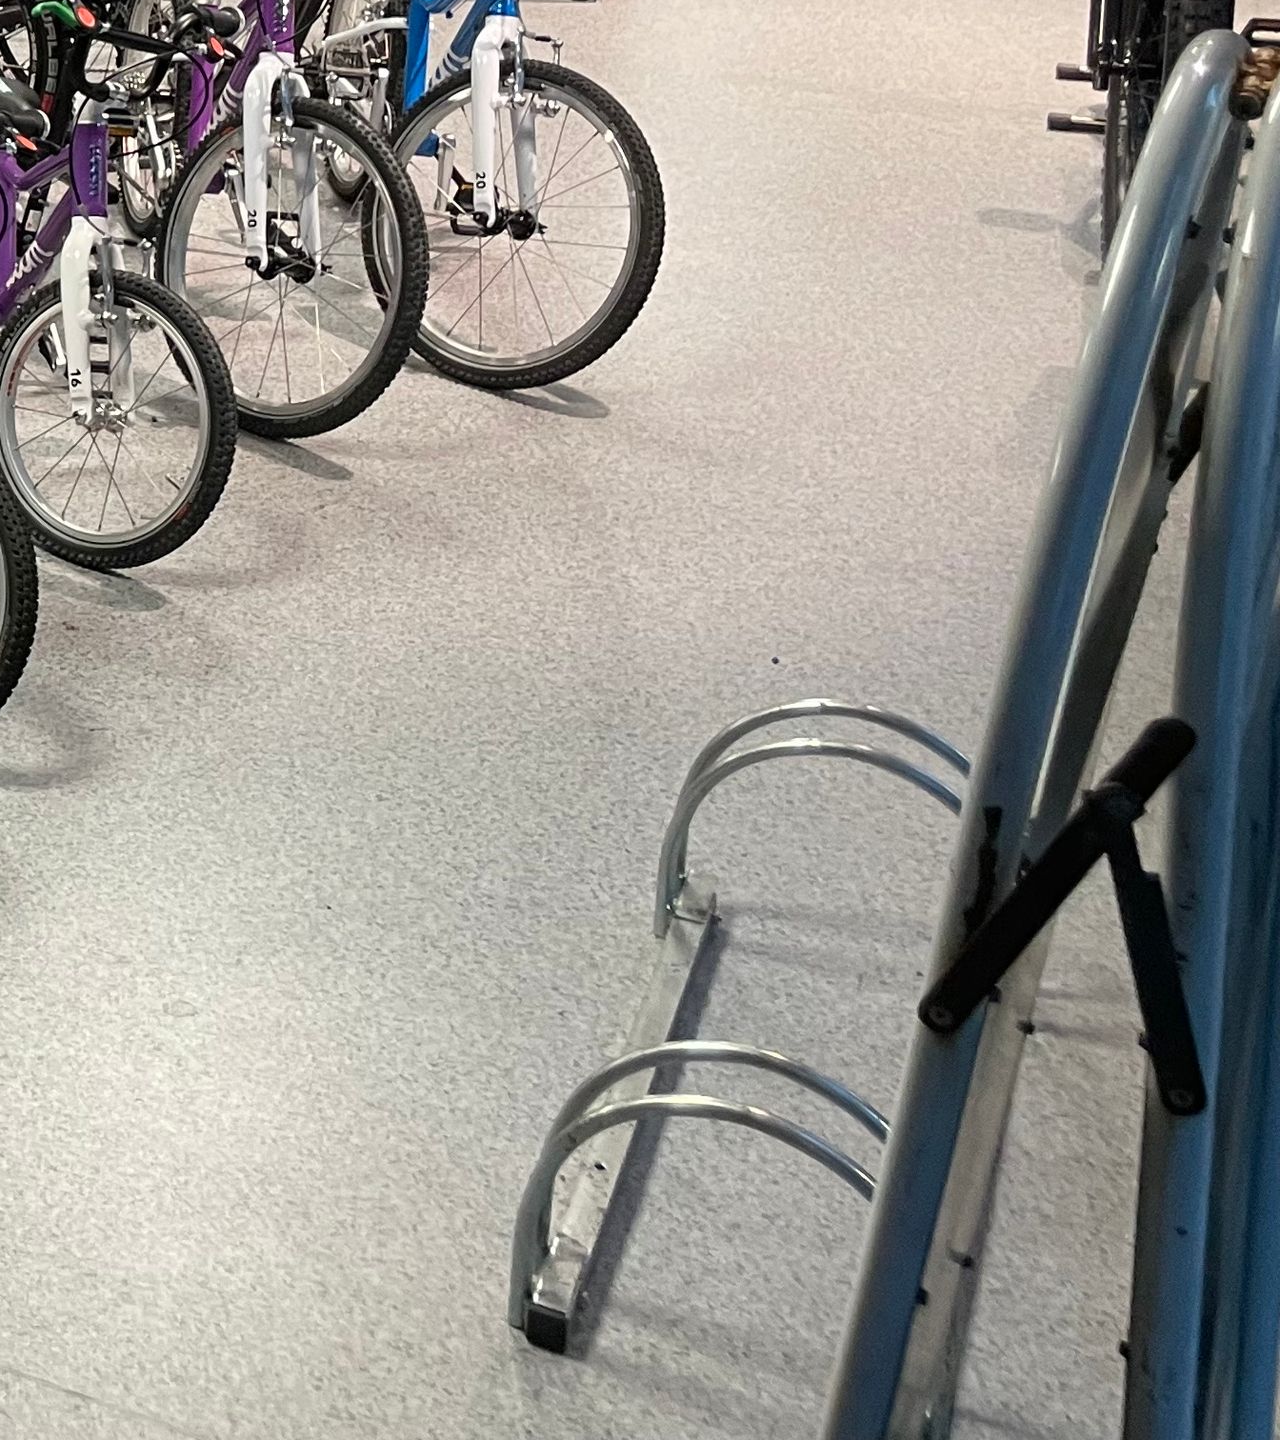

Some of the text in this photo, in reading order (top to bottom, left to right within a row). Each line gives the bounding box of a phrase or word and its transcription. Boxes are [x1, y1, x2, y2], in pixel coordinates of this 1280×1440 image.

[475, 171, 486, 189] 20
[247, 209, 257, 228] 20
[70, 368, 82, 388] 16
